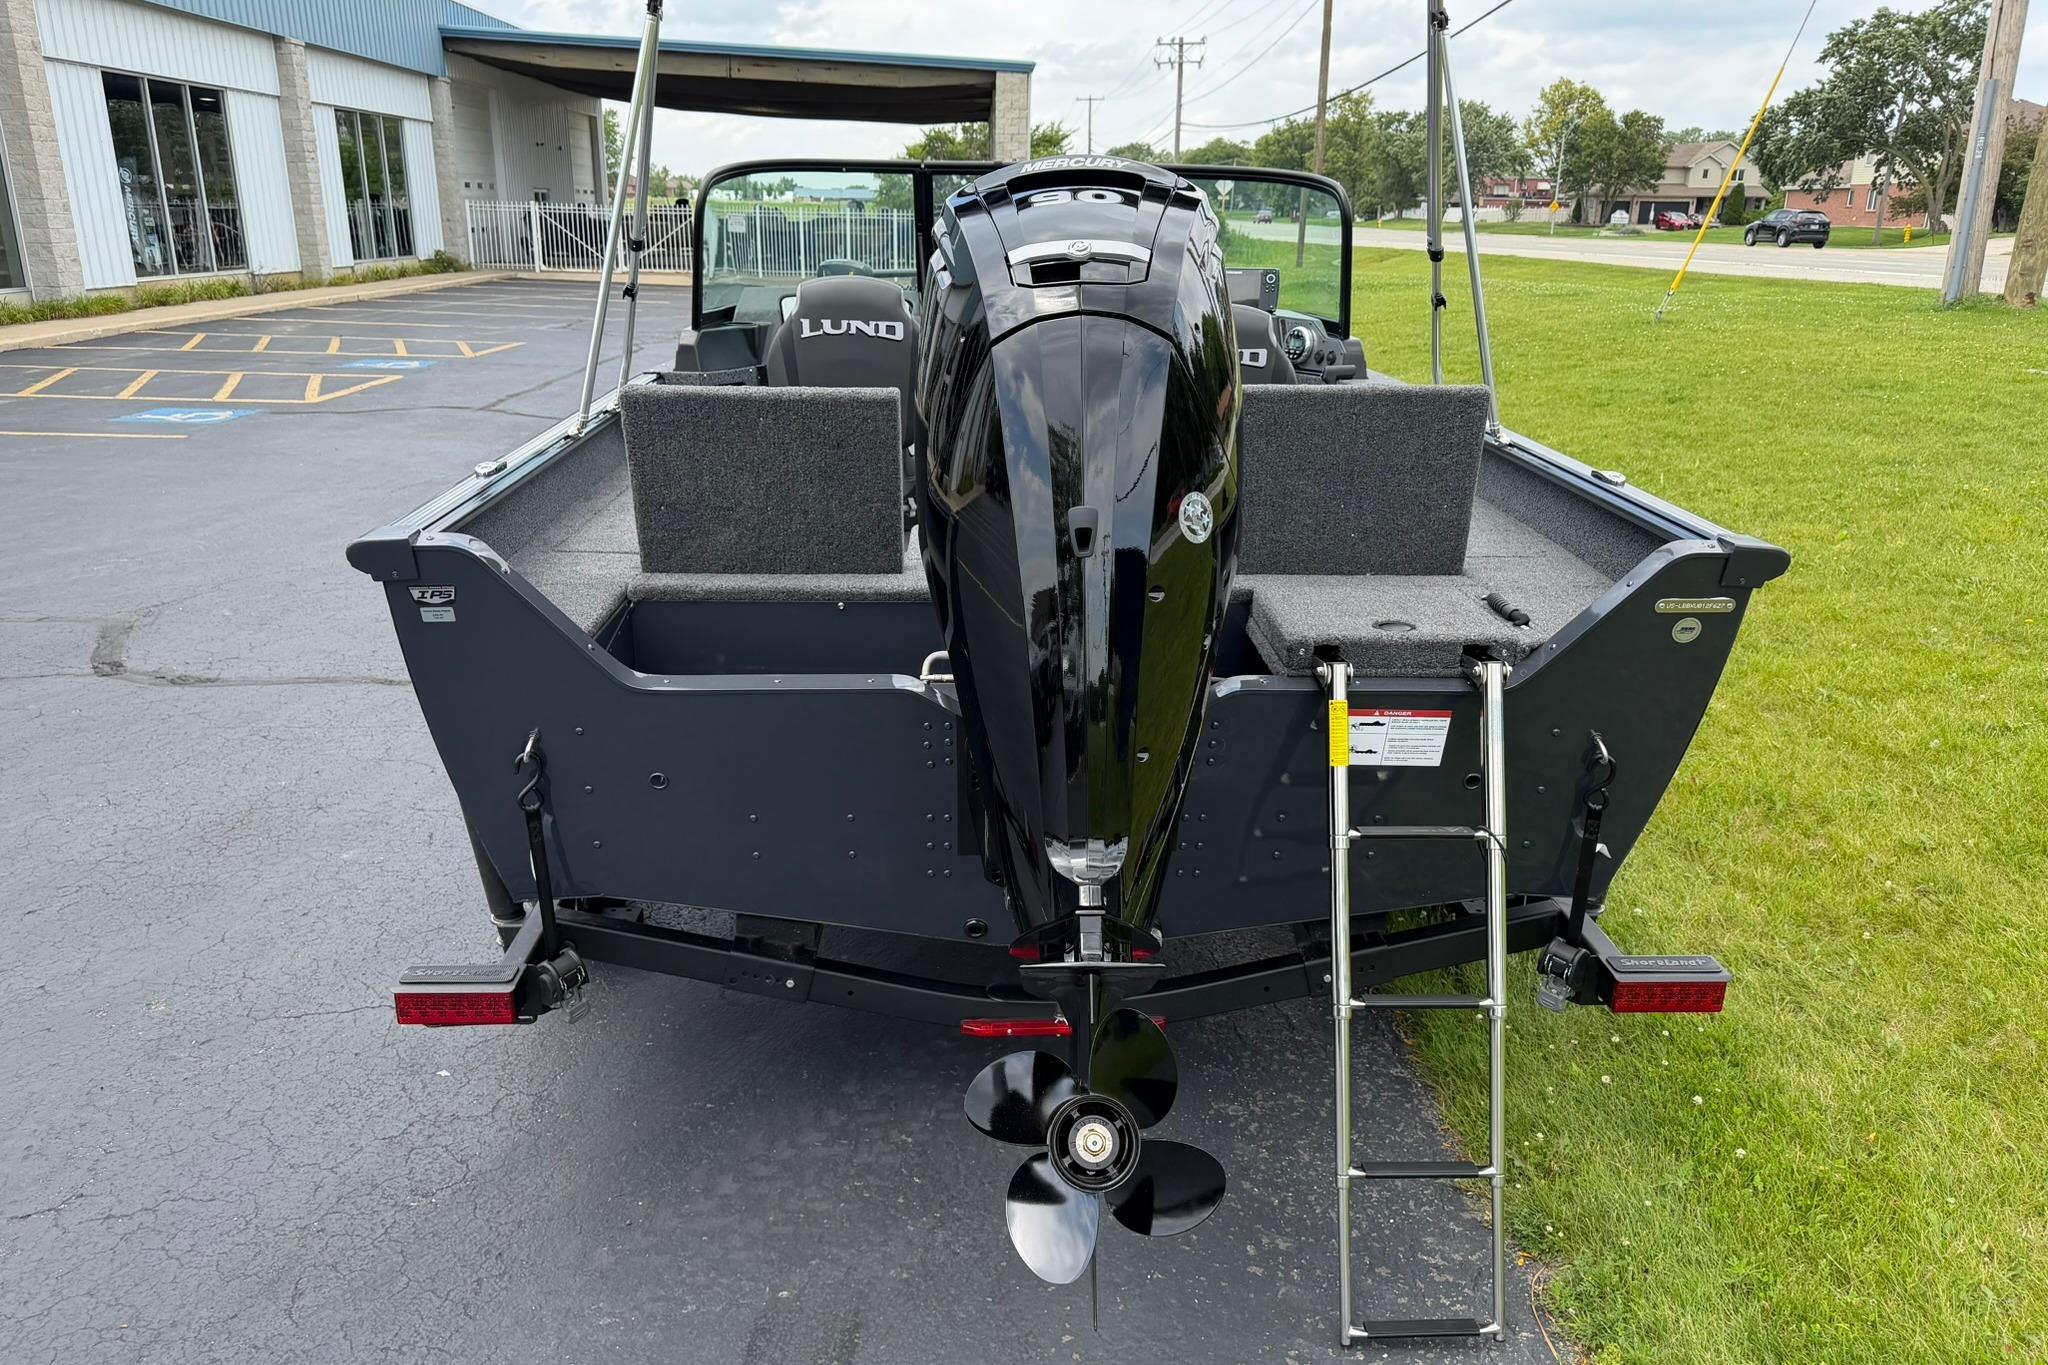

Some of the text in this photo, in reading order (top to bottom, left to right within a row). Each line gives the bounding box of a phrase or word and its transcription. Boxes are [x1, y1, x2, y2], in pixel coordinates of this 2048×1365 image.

[1020, 157, 1131, 174] MERCURY
[1029, 190, 1124, 207] 90
[124, 185, 139, 243] MERCURY
[800, 318, 904, 341] LUND
[417, 590, 453, 599] IPS
